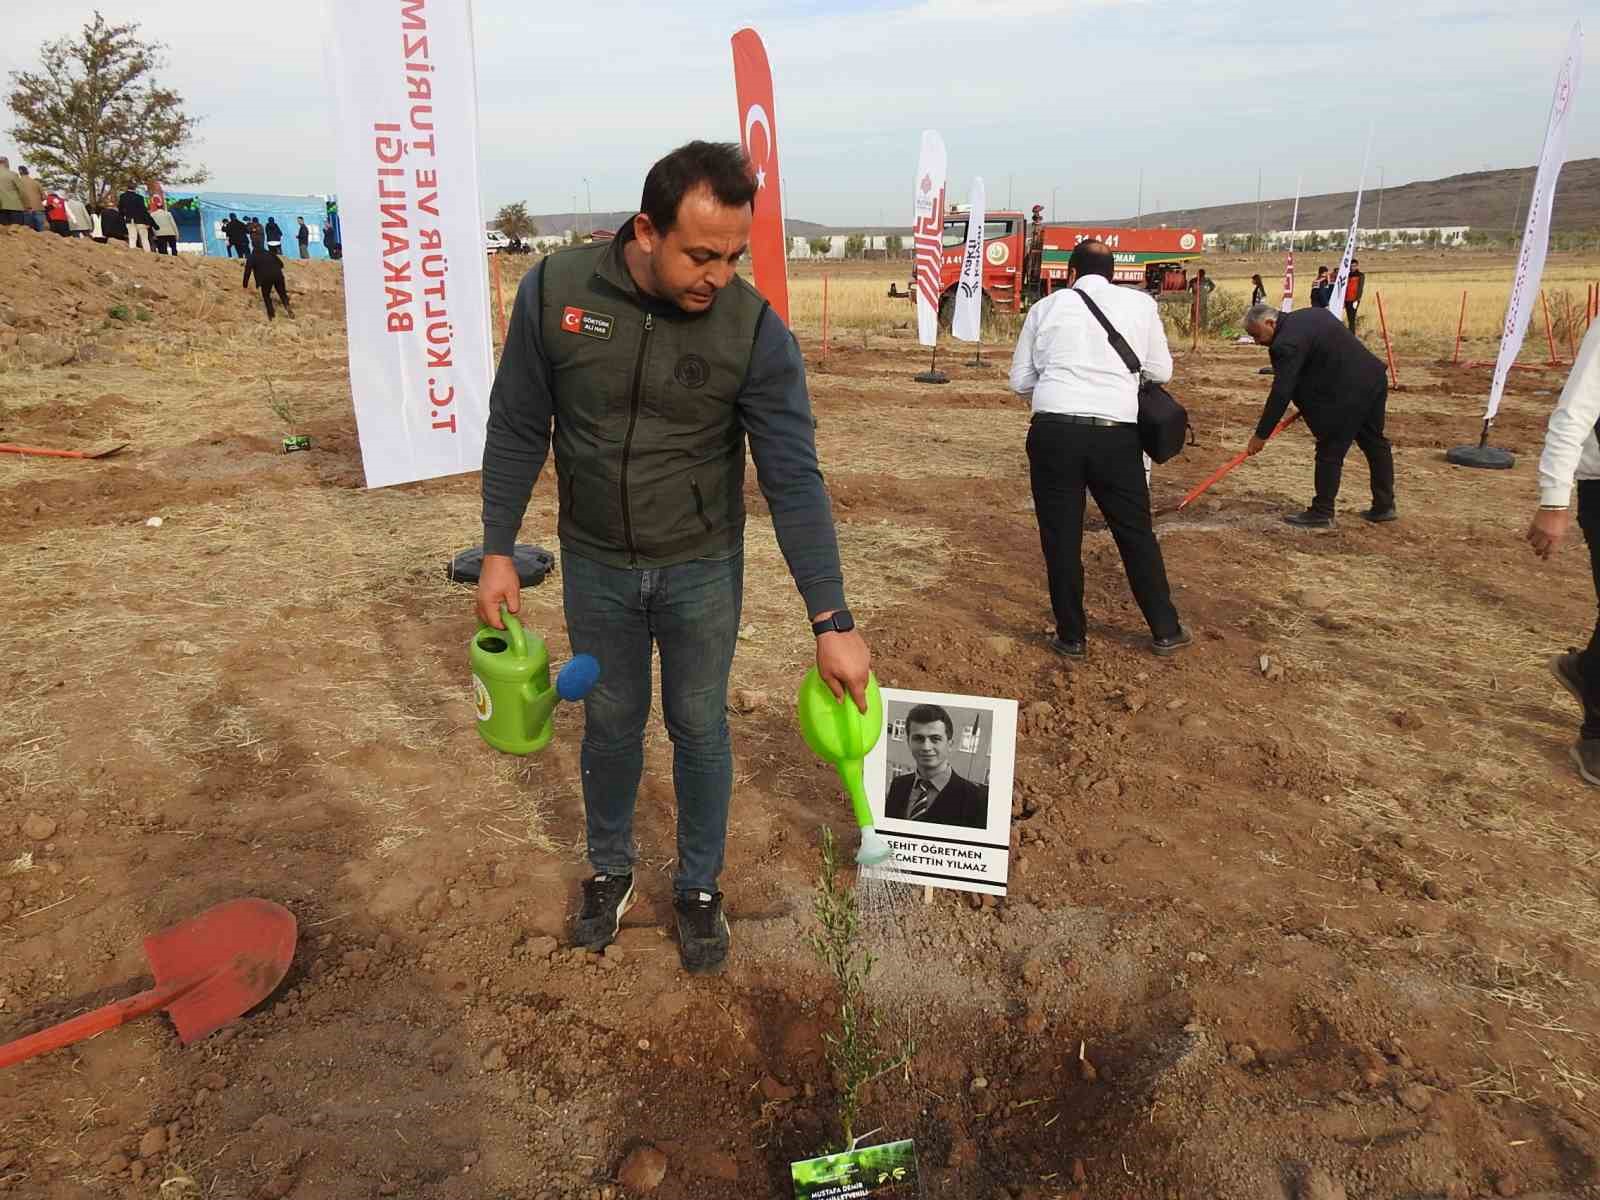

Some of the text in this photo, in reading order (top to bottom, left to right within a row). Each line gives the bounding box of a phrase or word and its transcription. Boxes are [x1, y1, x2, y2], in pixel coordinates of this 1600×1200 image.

[1104, 234, 1120, 247] 41
[1113, 253, 1136, 262] MAN
[888, 852, 988, 873] CMETTİN YILMAZ
